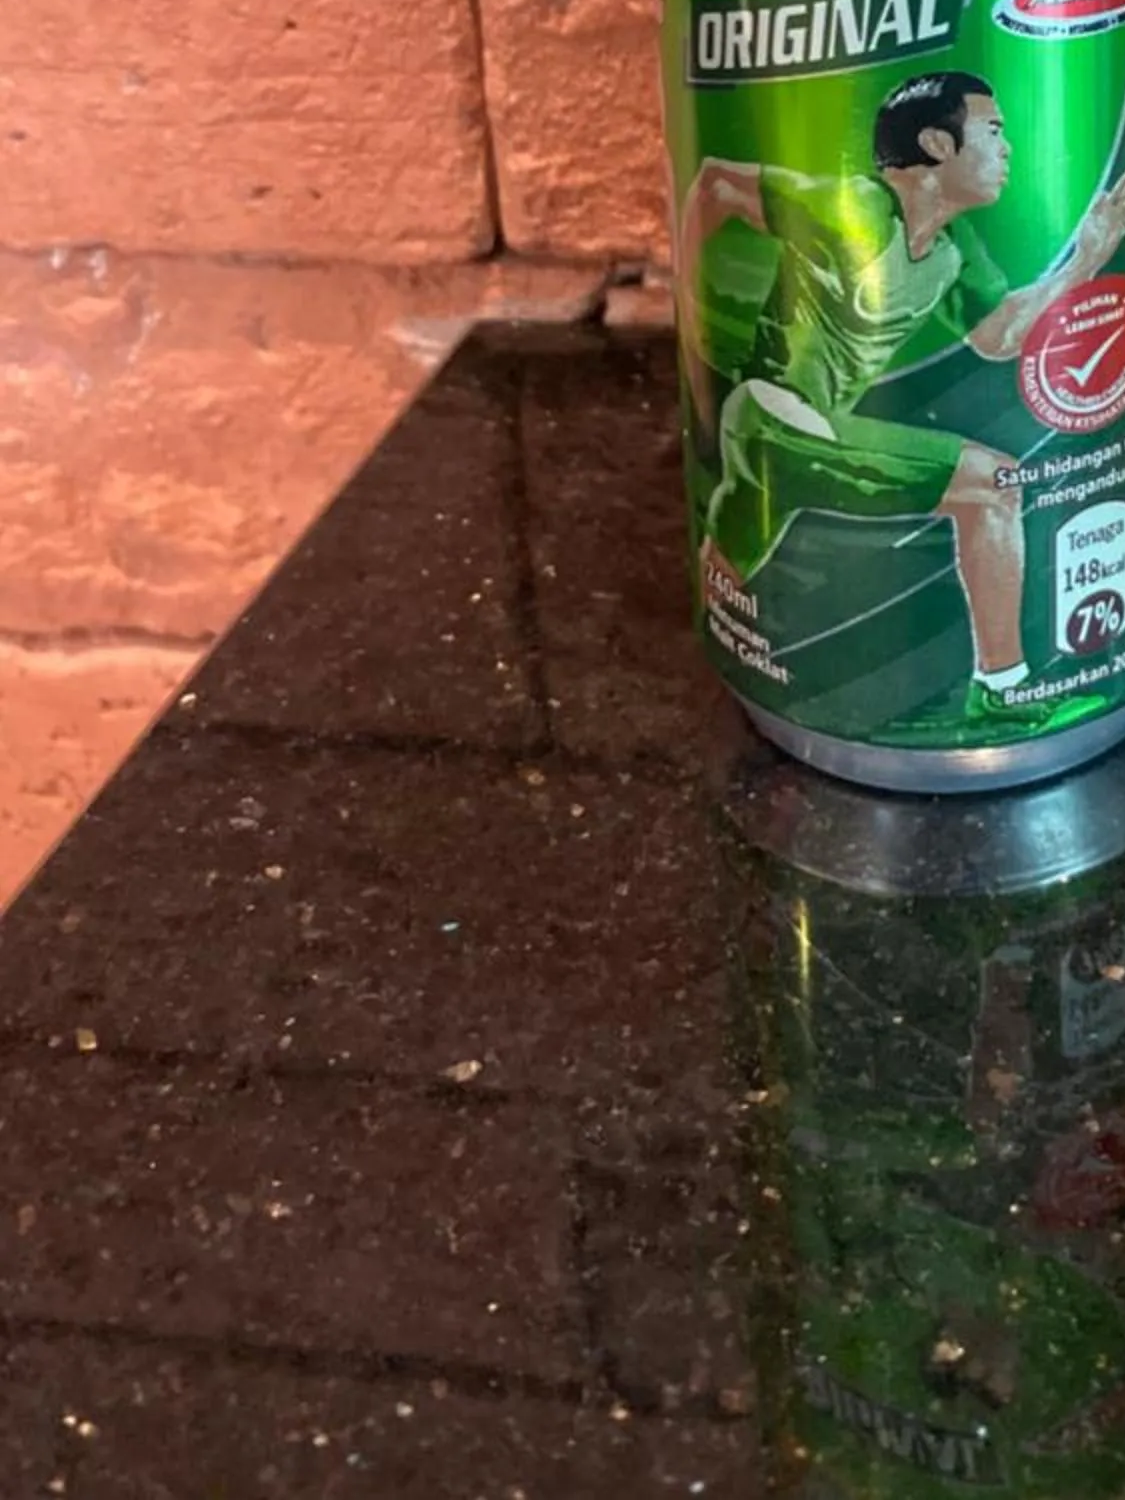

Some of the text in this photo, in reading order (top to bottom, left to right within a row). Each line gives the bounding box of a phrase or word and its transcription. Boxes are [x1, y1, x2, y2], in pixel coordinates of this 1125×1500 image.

[996, 465, 1038, 488] Satu
[1043, 443, 1121, 479] hidangan
[1066, 518, 1125, 552] Tenaga
[1077, 597, 1121, 643] 7%
[1003, 662, 1110, 705] Berdasarkan
